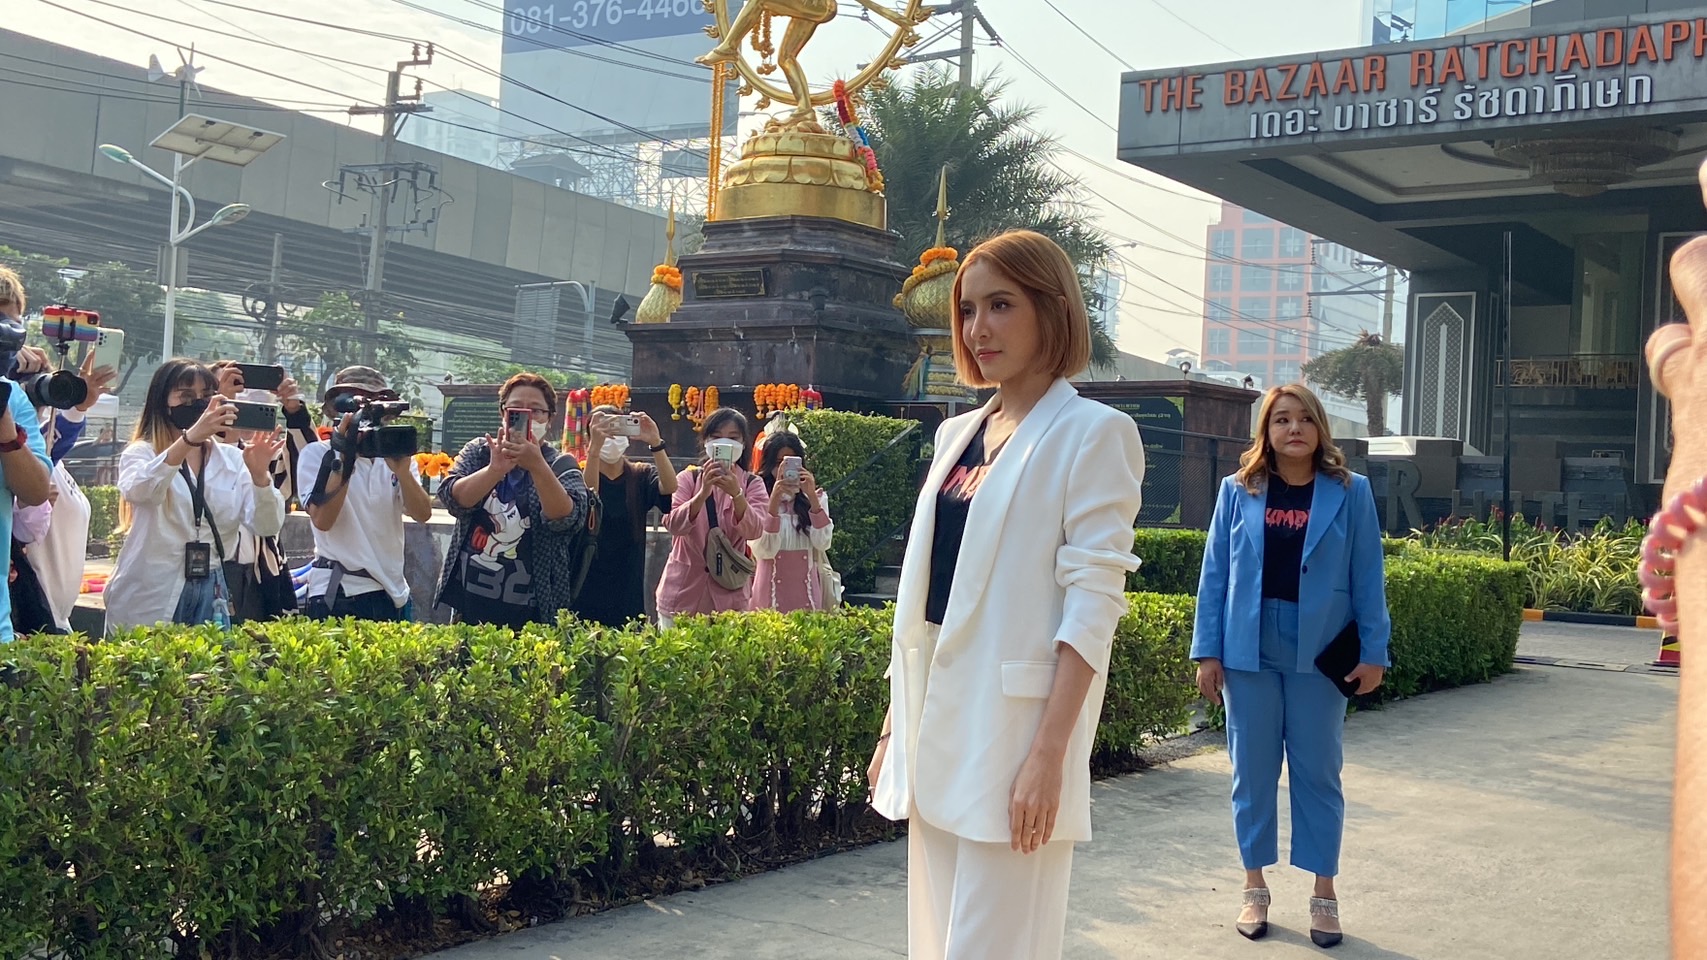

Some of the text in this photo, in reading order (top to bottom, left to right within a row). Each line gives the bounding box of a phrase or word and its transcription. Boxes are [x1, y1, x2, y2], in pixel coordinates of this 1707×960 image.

[1139, 74, 1203, 113] THE
[1224, 54, 1387, 106] BAZAAR
[1250, 74, 1652, 139] เดอะ บาซาร์ รัชดาภิเษก
